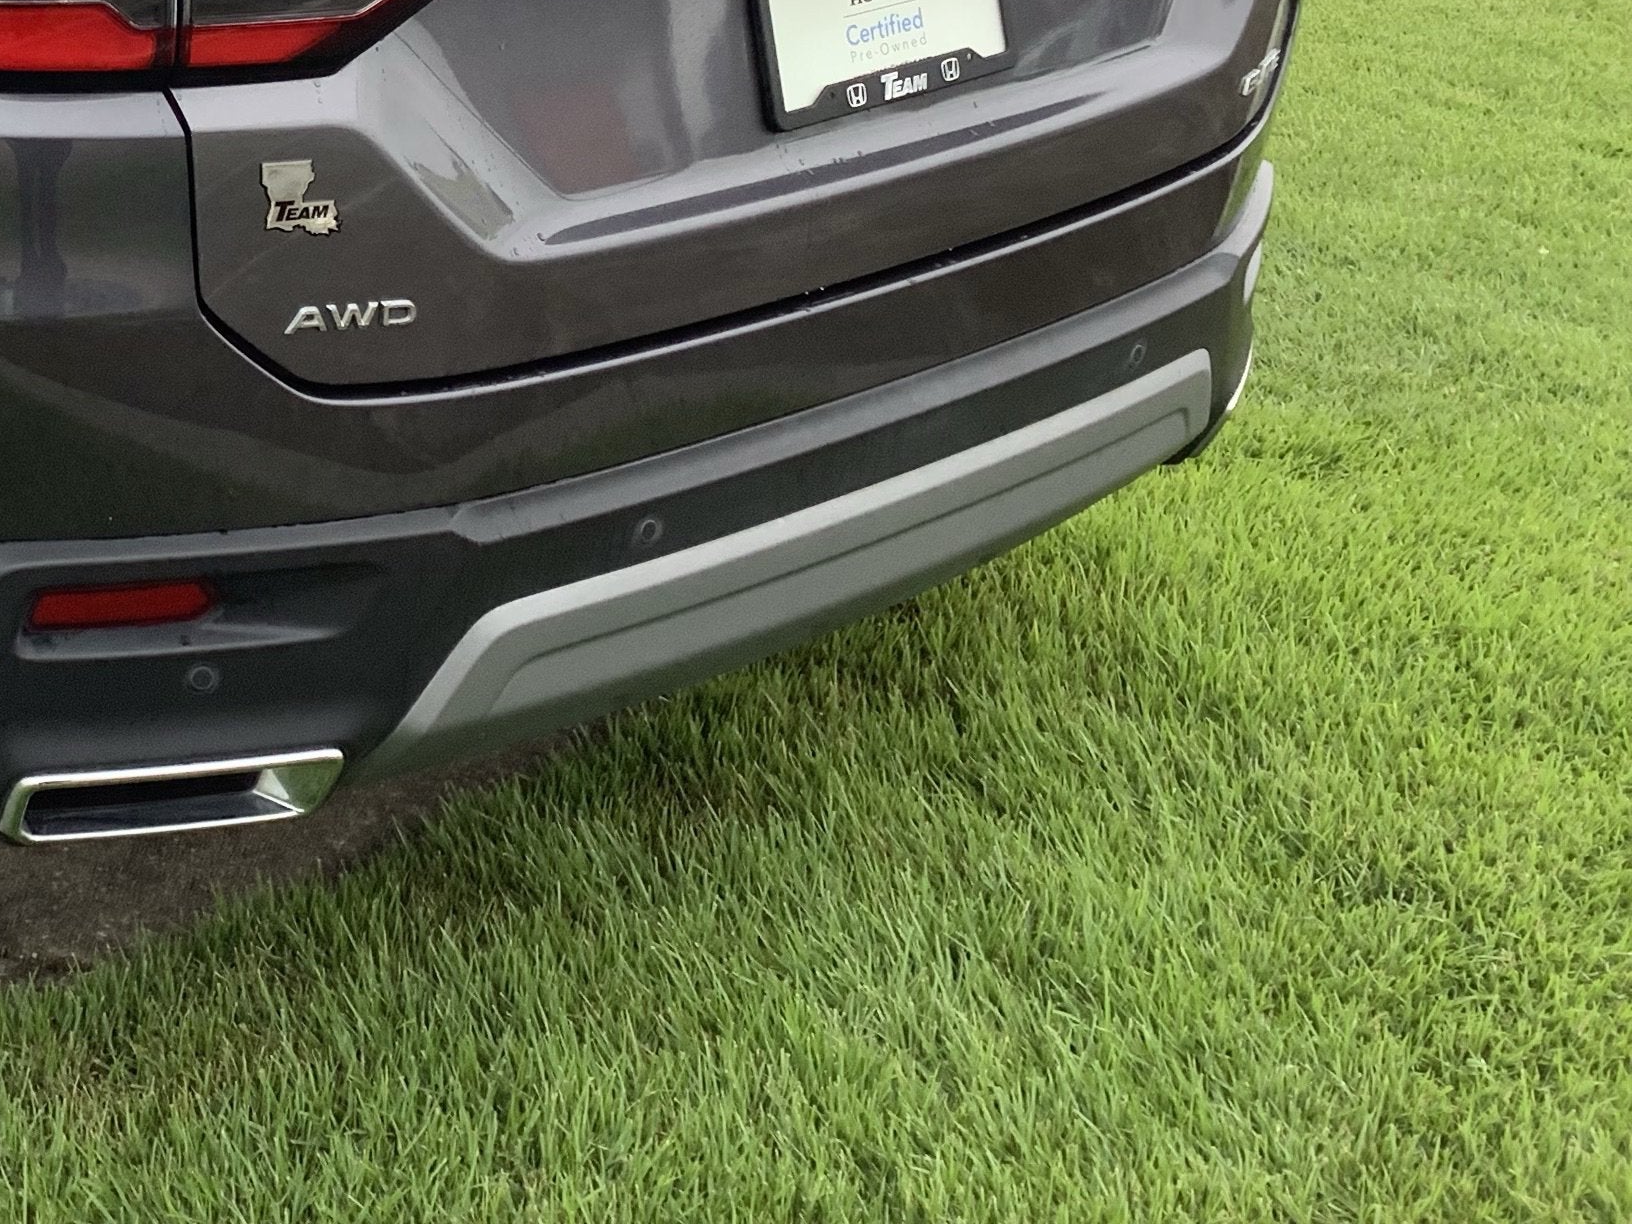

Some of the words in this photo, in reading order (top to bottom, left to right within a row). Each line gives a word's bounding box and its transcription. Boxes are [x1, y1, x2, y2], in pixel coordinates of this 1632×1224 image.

[845, 7, 925, 46] Certified
[849, 32, 928, 64] Pre-Owned
[881, 71, 928, 101] TEAM
[275, 200, 330, 223] TEAM
[283, 298, 417, 335] AWD
